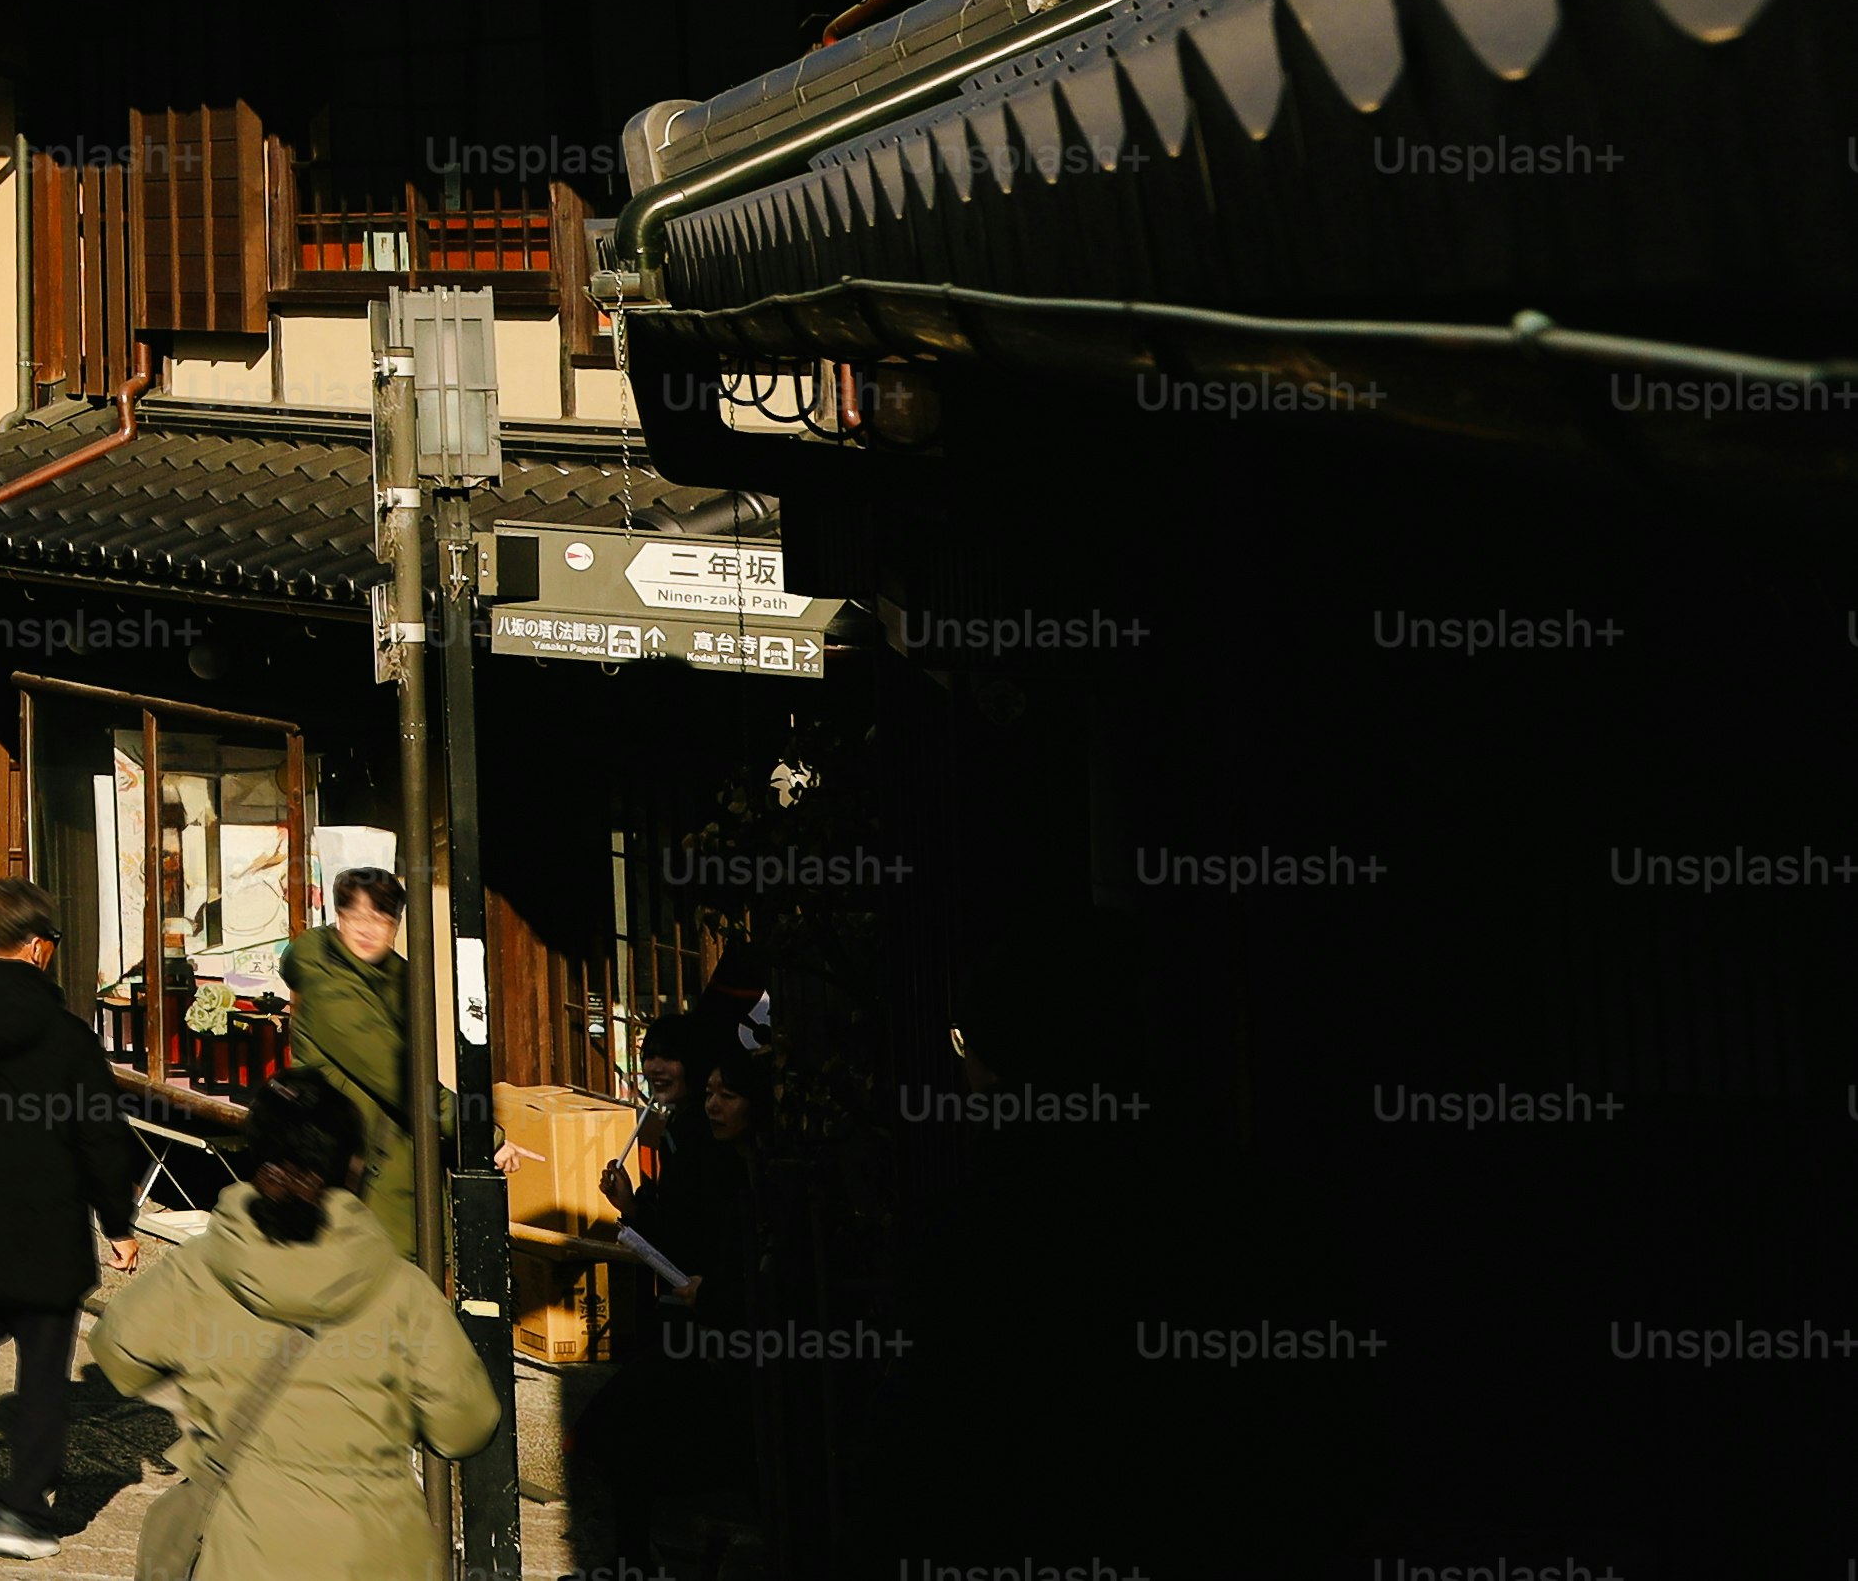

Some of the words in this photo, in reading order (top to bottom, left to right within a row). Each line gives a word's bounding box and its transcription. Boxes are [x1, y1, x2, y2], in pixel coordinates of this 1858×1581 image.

[669, 552, 777, 585] 二年坂
[657, 589, 746, 607] Ninen-zaka
[752, 596, 788, 609] Path
[531, 640, 568, 652] Yasaka
[569, 644, 606, 656] Pagoda
[693, 631, 758, 654] 高台寺
[686, 652, 720, 664] Kodaiji
